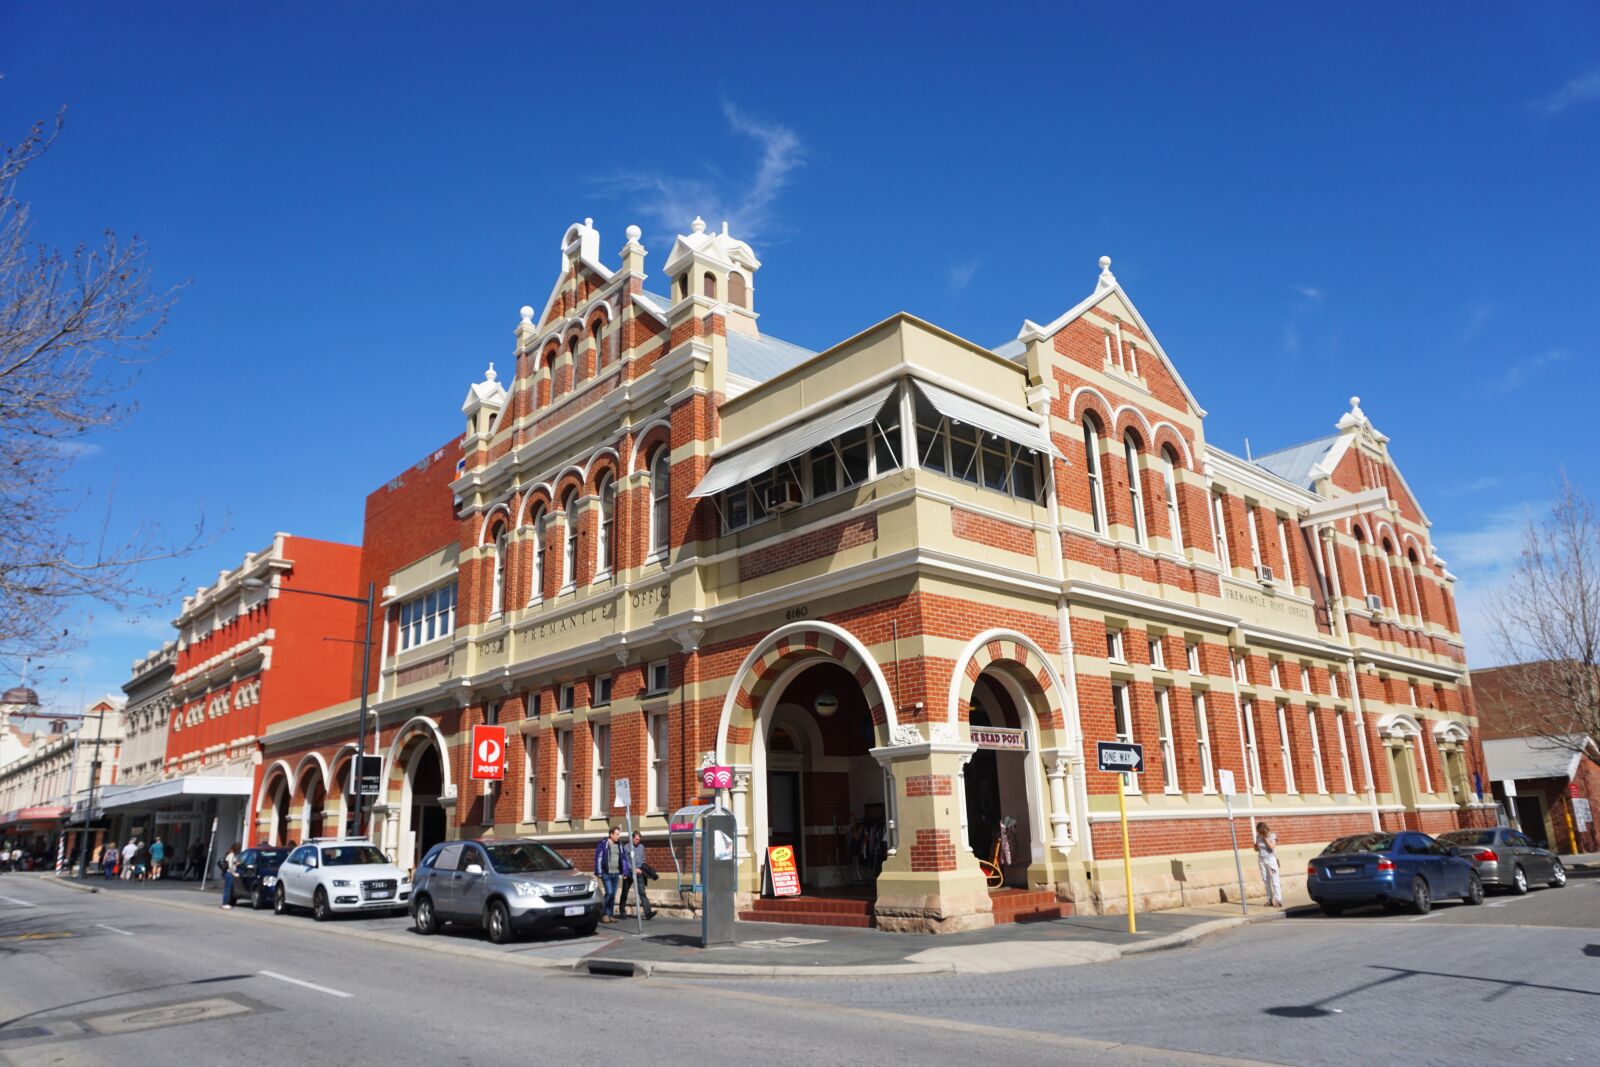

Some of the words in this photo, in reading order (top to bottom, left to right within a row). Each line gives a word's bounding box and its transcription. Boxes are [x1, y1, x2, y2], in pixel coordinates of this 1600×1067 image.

[632, 585, 668, 608] OFFIC
[1225, 589, 1266, 608] FREMANTLE
[1270, 600, 1285, 612] POST
[785, 606, 808, 621] 6160
[524, 605, 607, 644] FREMANTLE
[970, 732, 980, 743] HE
[980, 733, 1000, 743] BEAD
[1001, 734, 1020, 744] POST
[1104, 751, 1117, 762] ONE
[1119, 752, 1131, 762] WAY
[478, 765, 499, 773] POST
